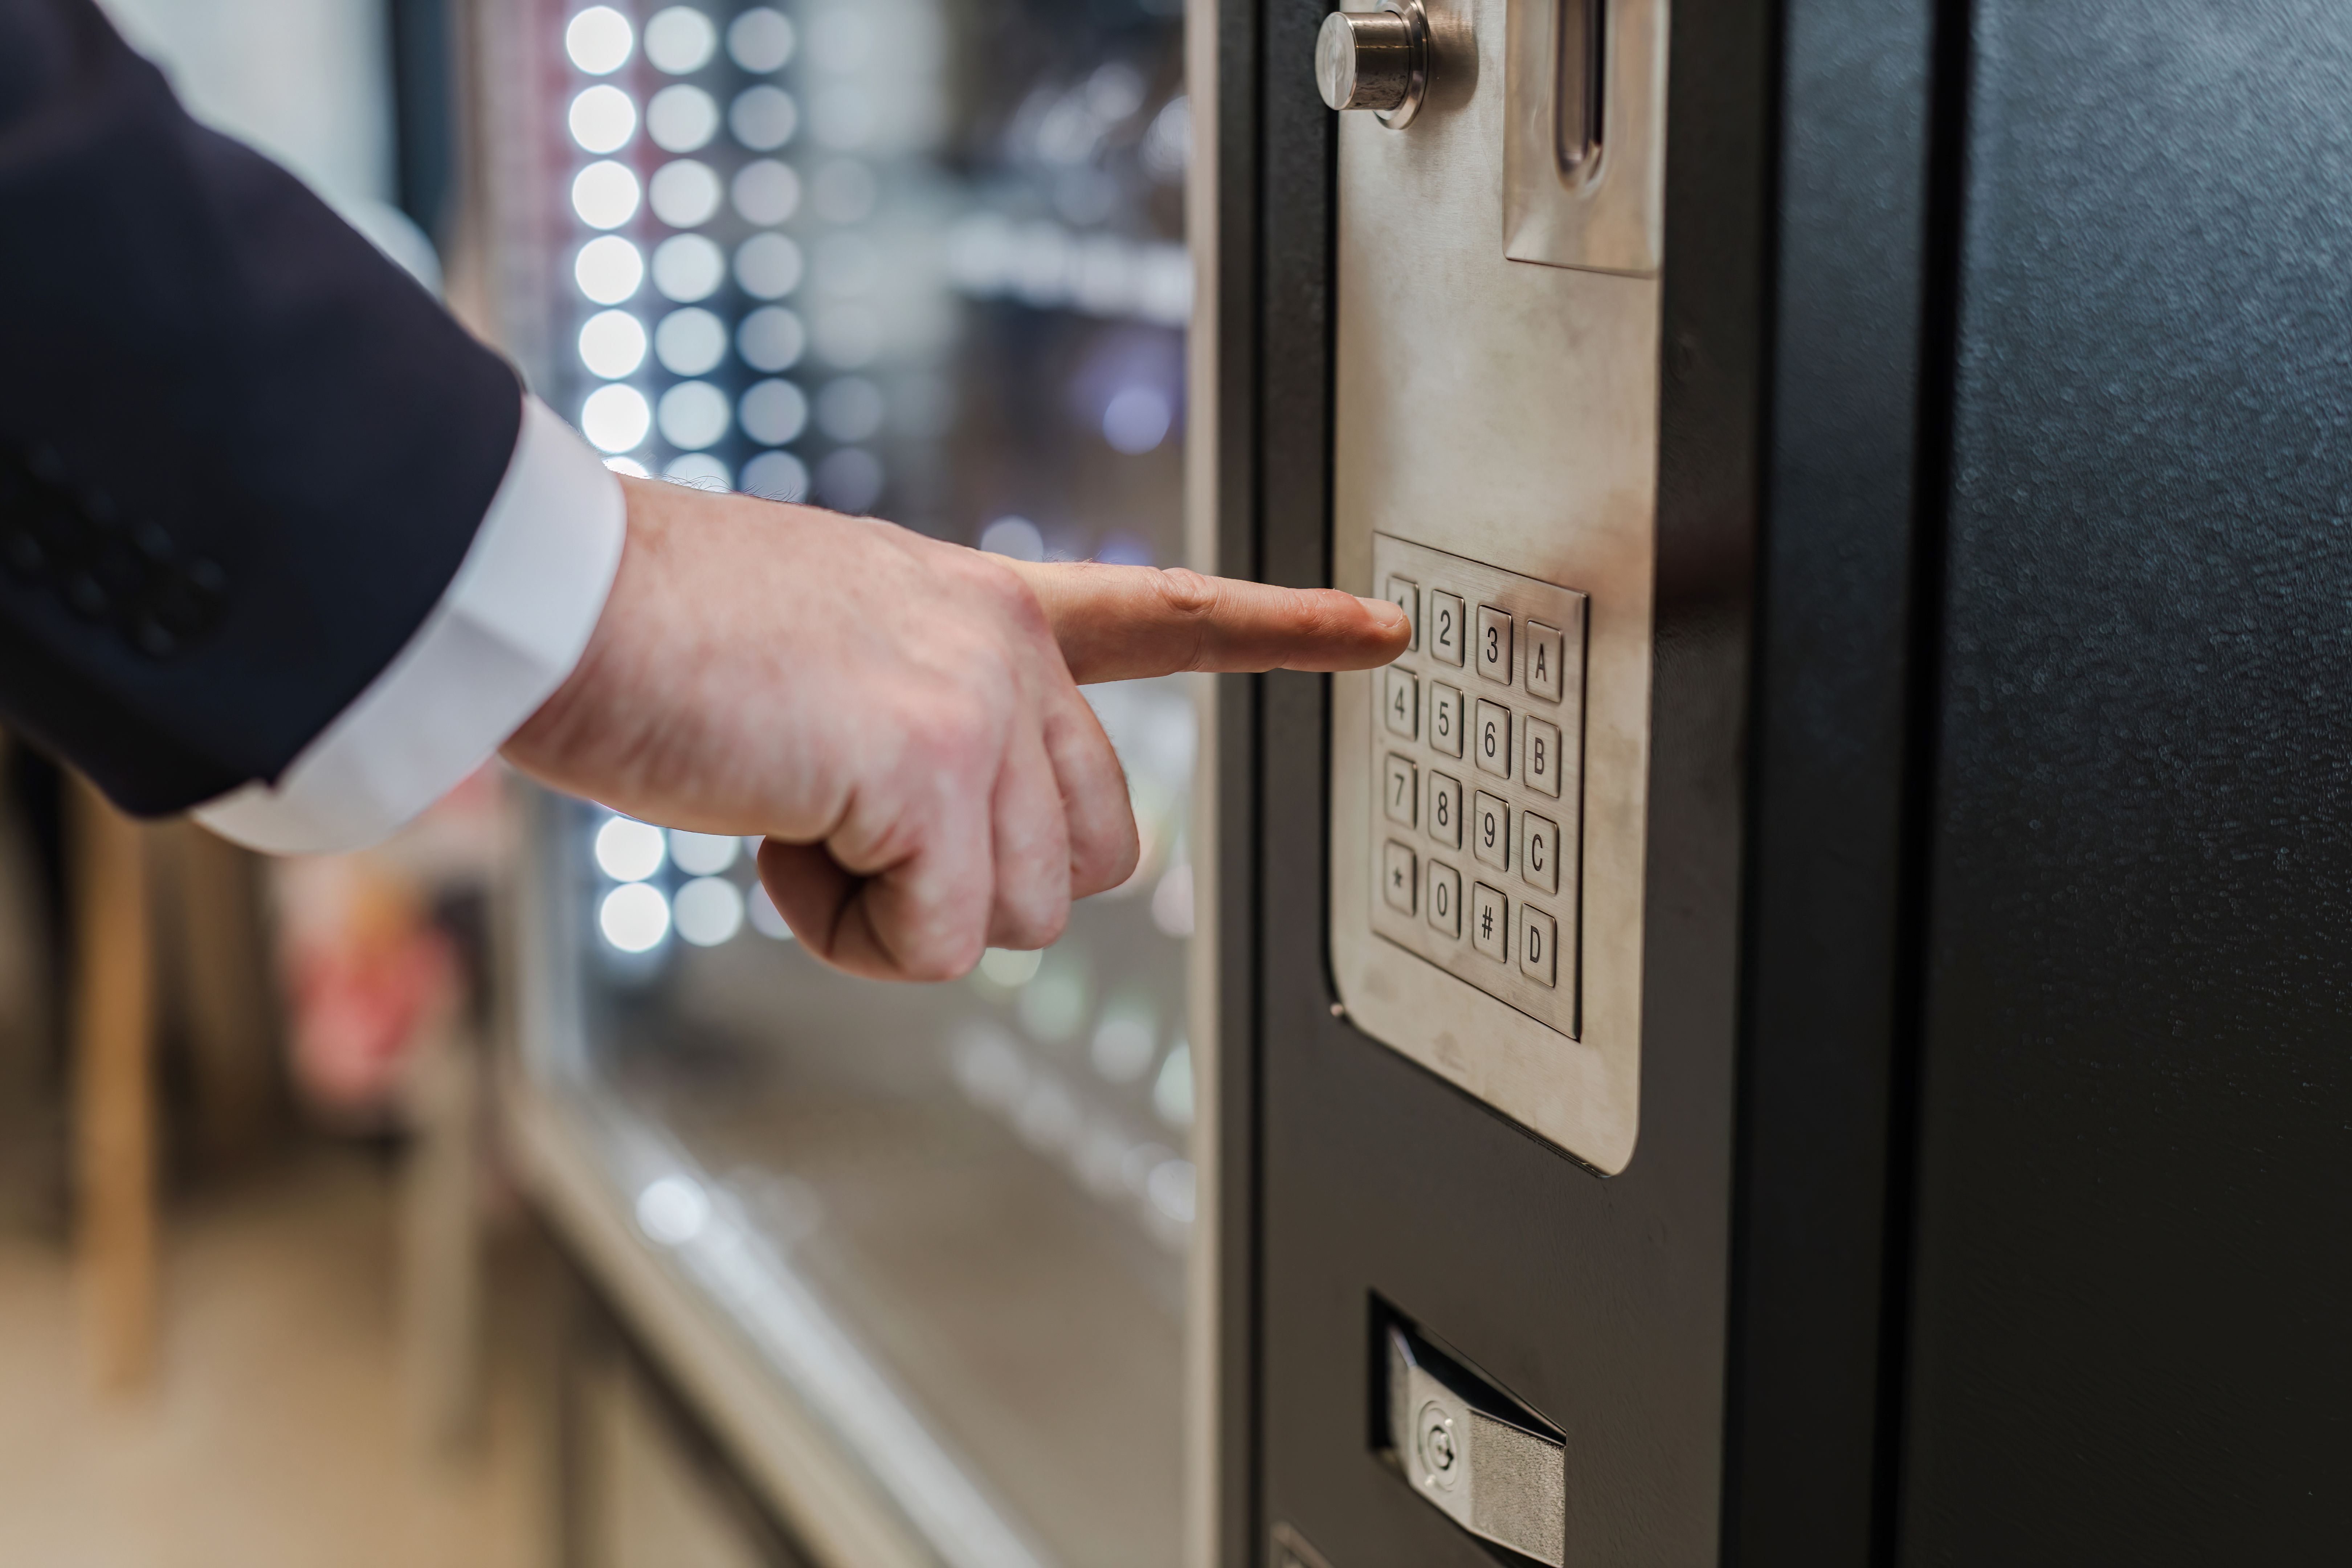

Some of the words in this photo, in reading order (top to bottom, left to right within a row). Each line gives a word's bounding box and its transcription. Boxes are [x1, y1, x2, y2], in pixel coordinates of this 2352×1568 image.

[1440, 609, 1451, 647] 2
[1486, 626, 1498, 663] 3
[1535, 643, 1547, 682] A
[1394, 686, 1406, 720] 4
[1438, 701, 1450, 737] 5
[1484, 721, 1496, 758] 6
[1534, 736, 1545, 775] B
[1394, 772, 1405, 806] 7
[1437, 791, 1449, 827] 8
[1484, 812, 1495, 848] 9
[1531, 833, 1543, 872] C
[1481, 905, 1493, 940] #
[1529, 925, 1541, 964] D
